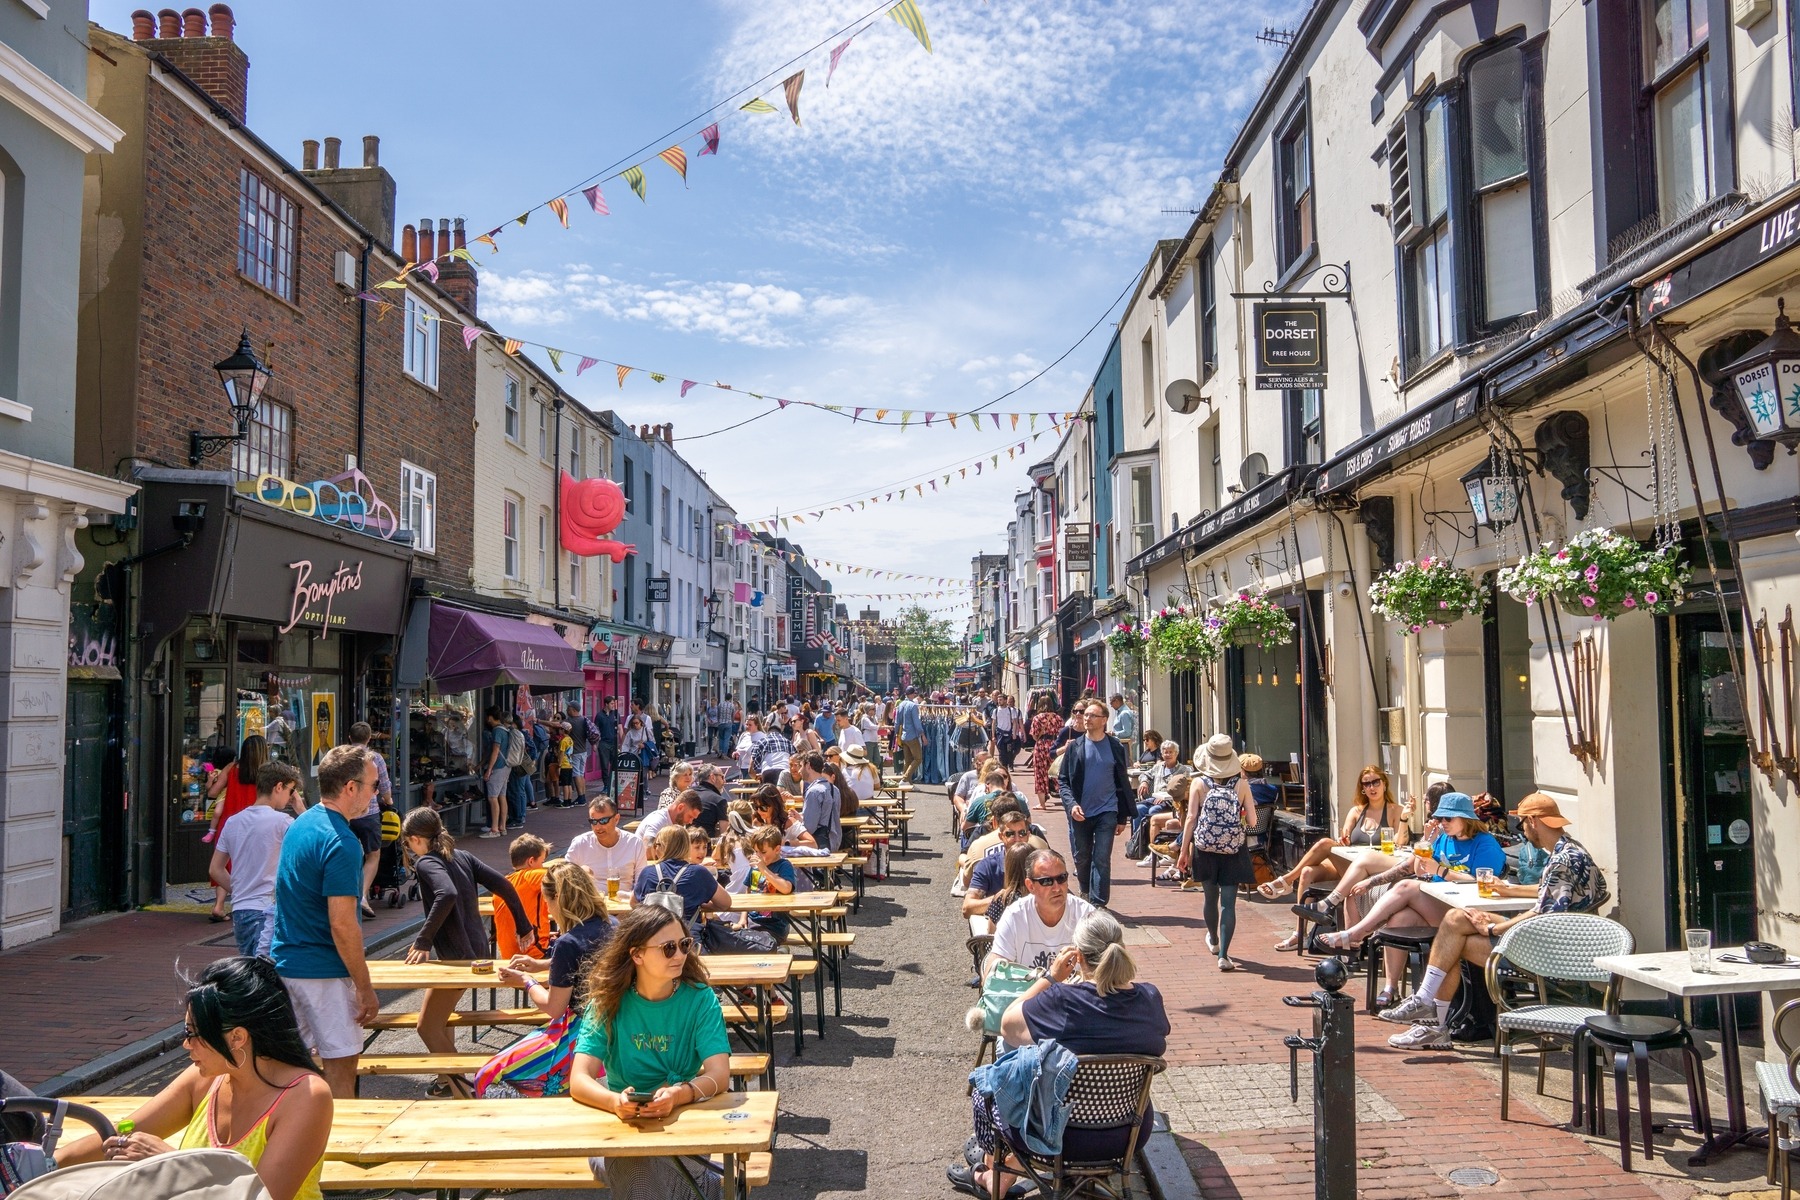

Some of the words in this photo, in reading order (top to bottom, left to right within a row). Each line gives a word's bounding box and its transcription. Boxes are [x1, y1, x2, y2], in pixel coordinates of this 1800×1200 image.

[1759, 204, 1800, 253] LIVE
[1266, 329, 1316, 339] DORSET
[1739, 366, 1770, 386] DORSET
[1388, 427, 1409, 453] SUNDAY
[1410, 413, 1432, 442] ROASTS
[1346, 460, 1356, 477] FISH
[1360, 447, 1374, 470] CHIPS
[649, 581, 667, 591] Jump
[654, 590, 667, 599] Gun
[279, 560, 363, 640] Bromptons
